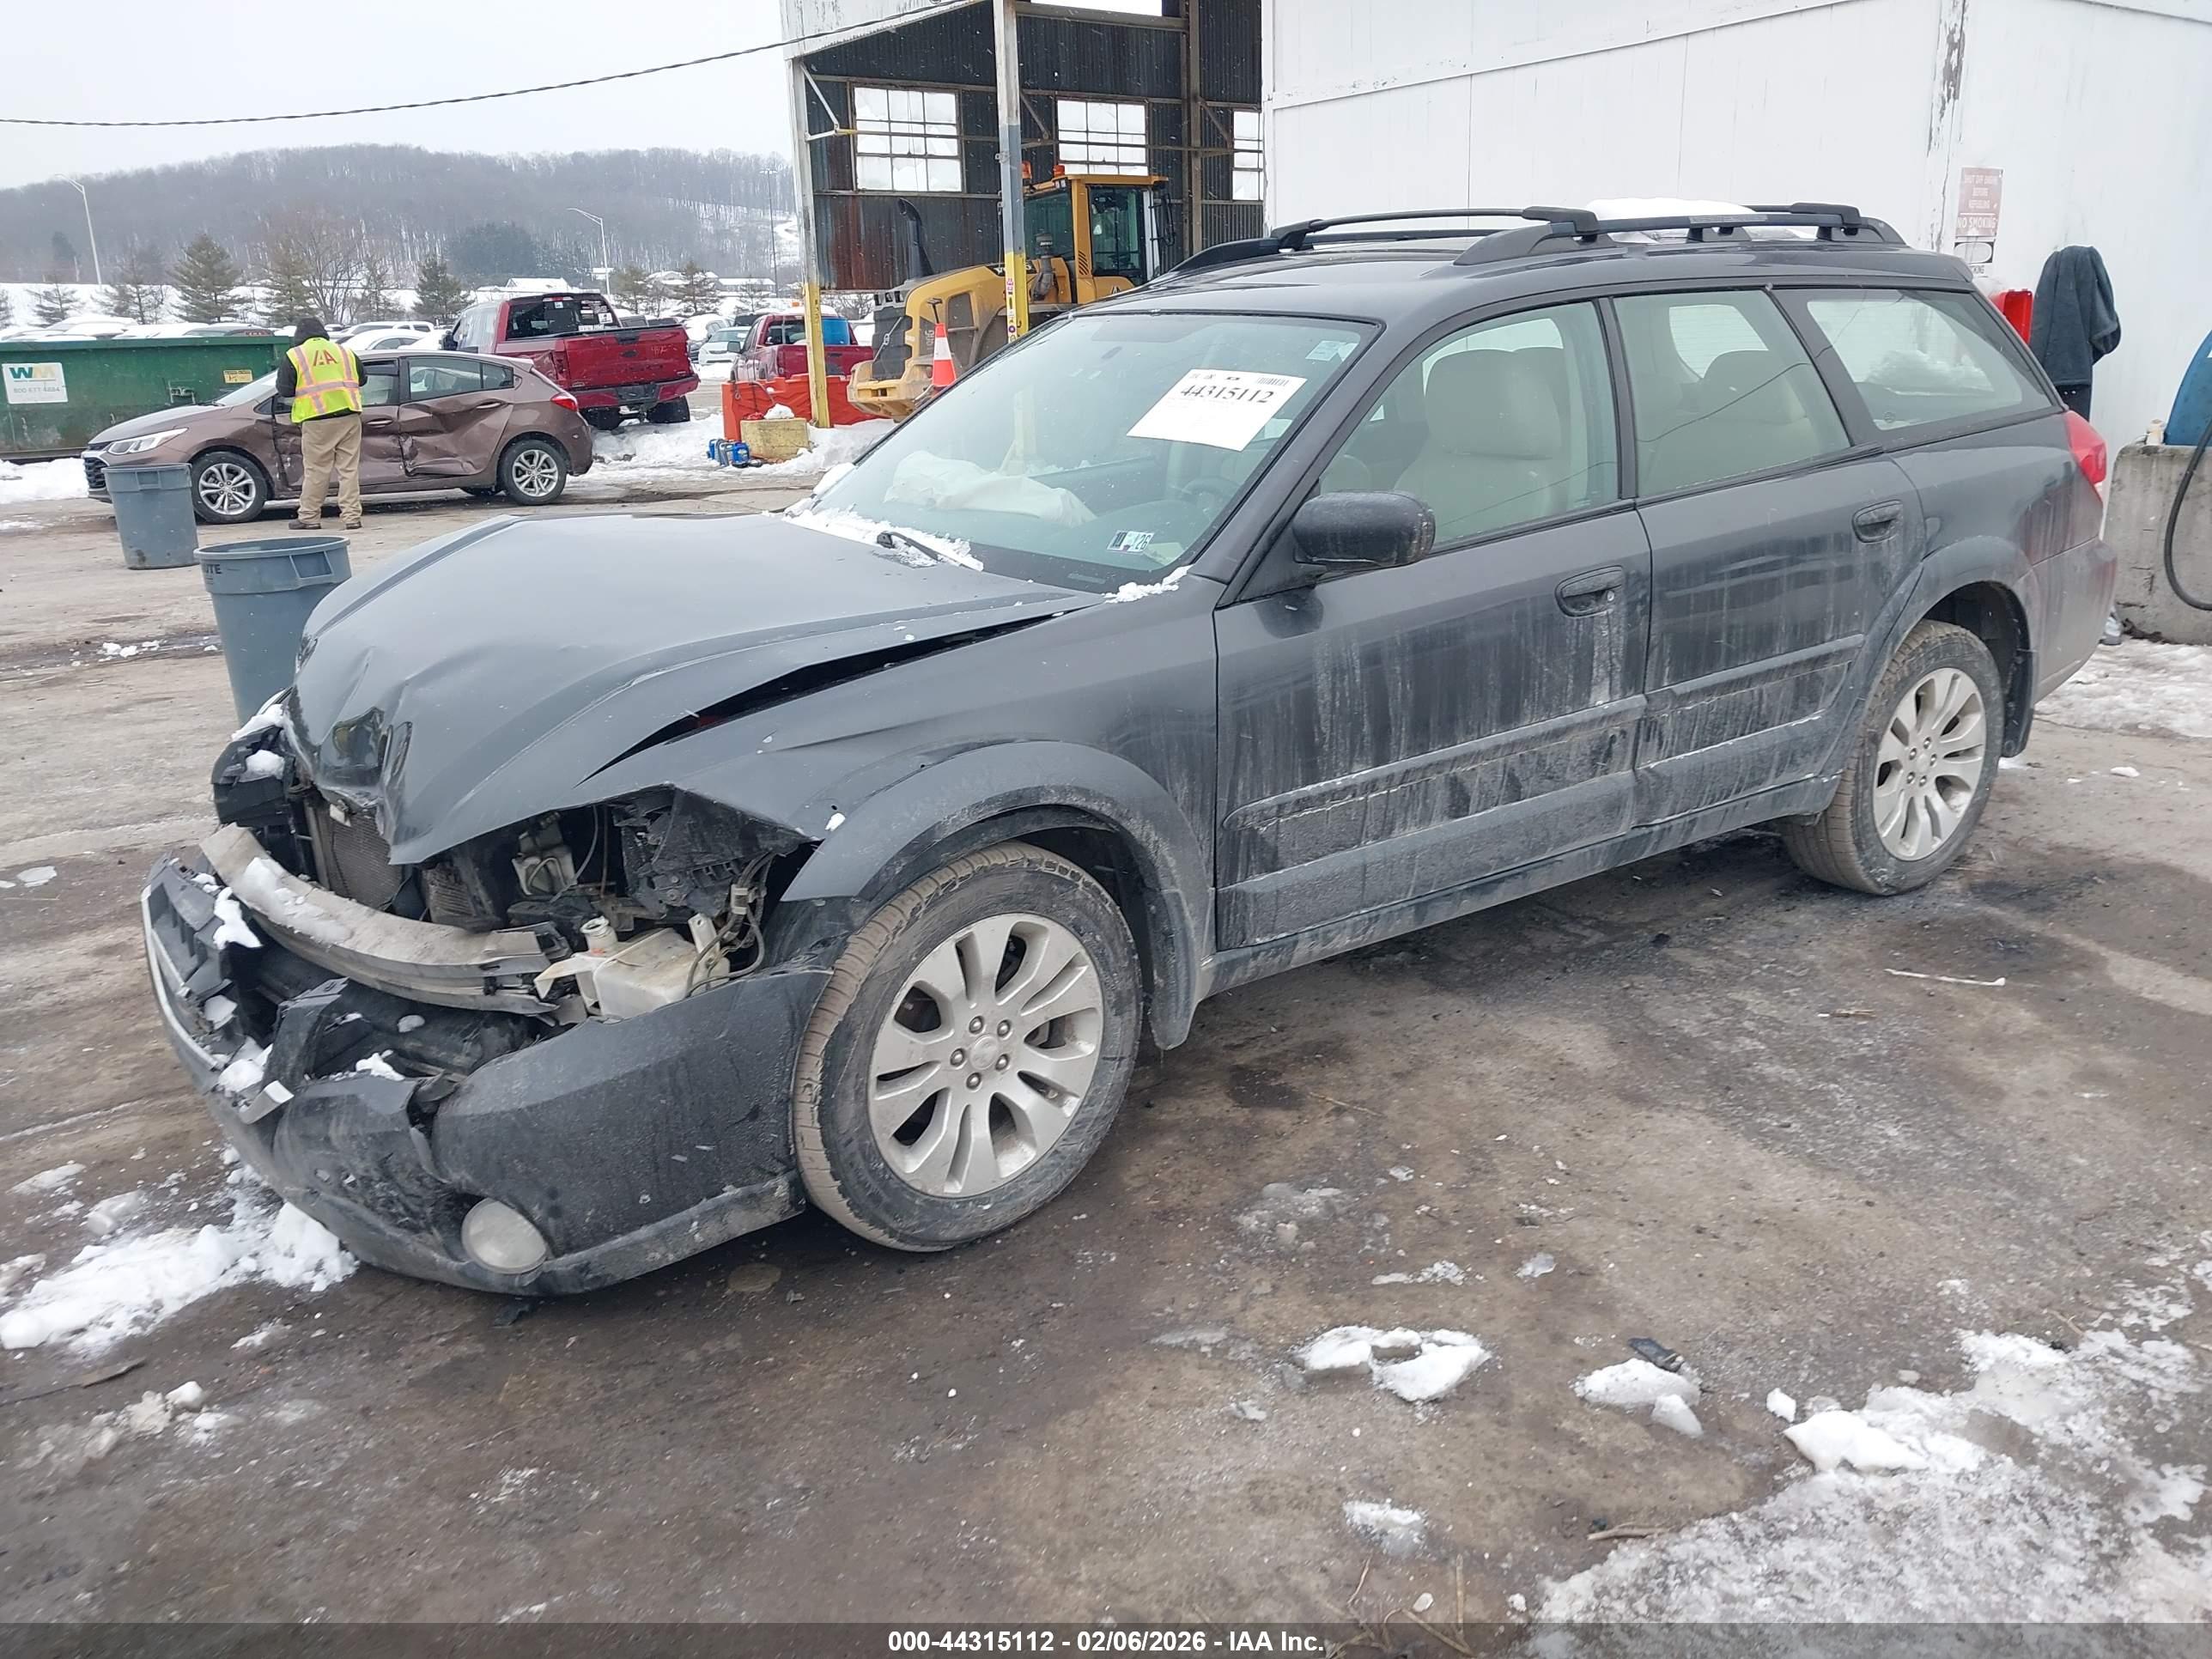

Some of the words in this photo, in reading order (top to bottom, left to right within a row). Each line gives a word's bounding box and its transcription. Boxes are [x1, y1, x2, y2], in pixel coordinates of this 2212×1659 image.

[1958, 216, 1967, 228] NO
[1969, 216, 1996, 228] SMOKING
[1181, 384, 1274, 404] 44315112
